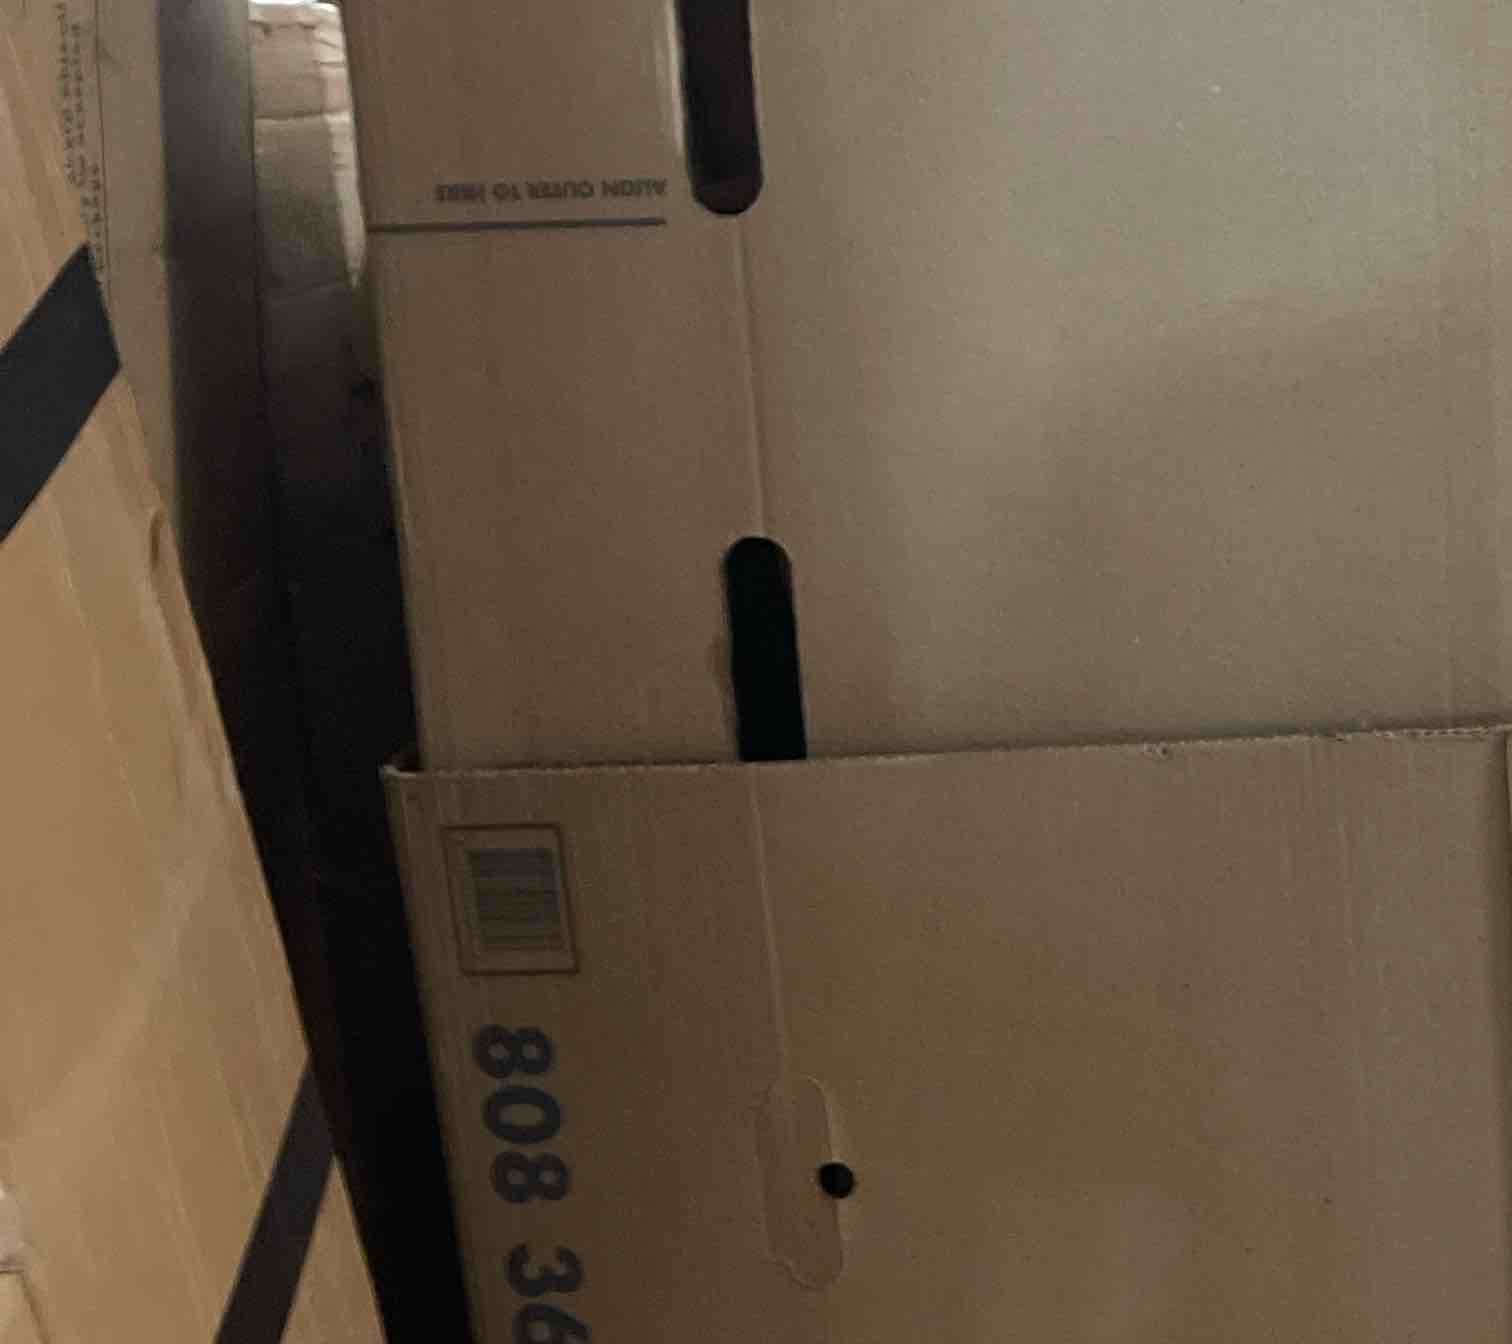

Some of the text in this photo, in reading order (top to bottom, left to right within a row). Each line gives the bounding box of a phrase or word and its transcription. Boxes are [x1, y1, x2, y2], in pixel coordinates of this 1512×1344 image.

[491, 183, 521, 201] TO
[525, 179, 594, 200] OUTER
[600, 177, 668, 198] ALIGN
[473, 1024, 568, 1203] 808
